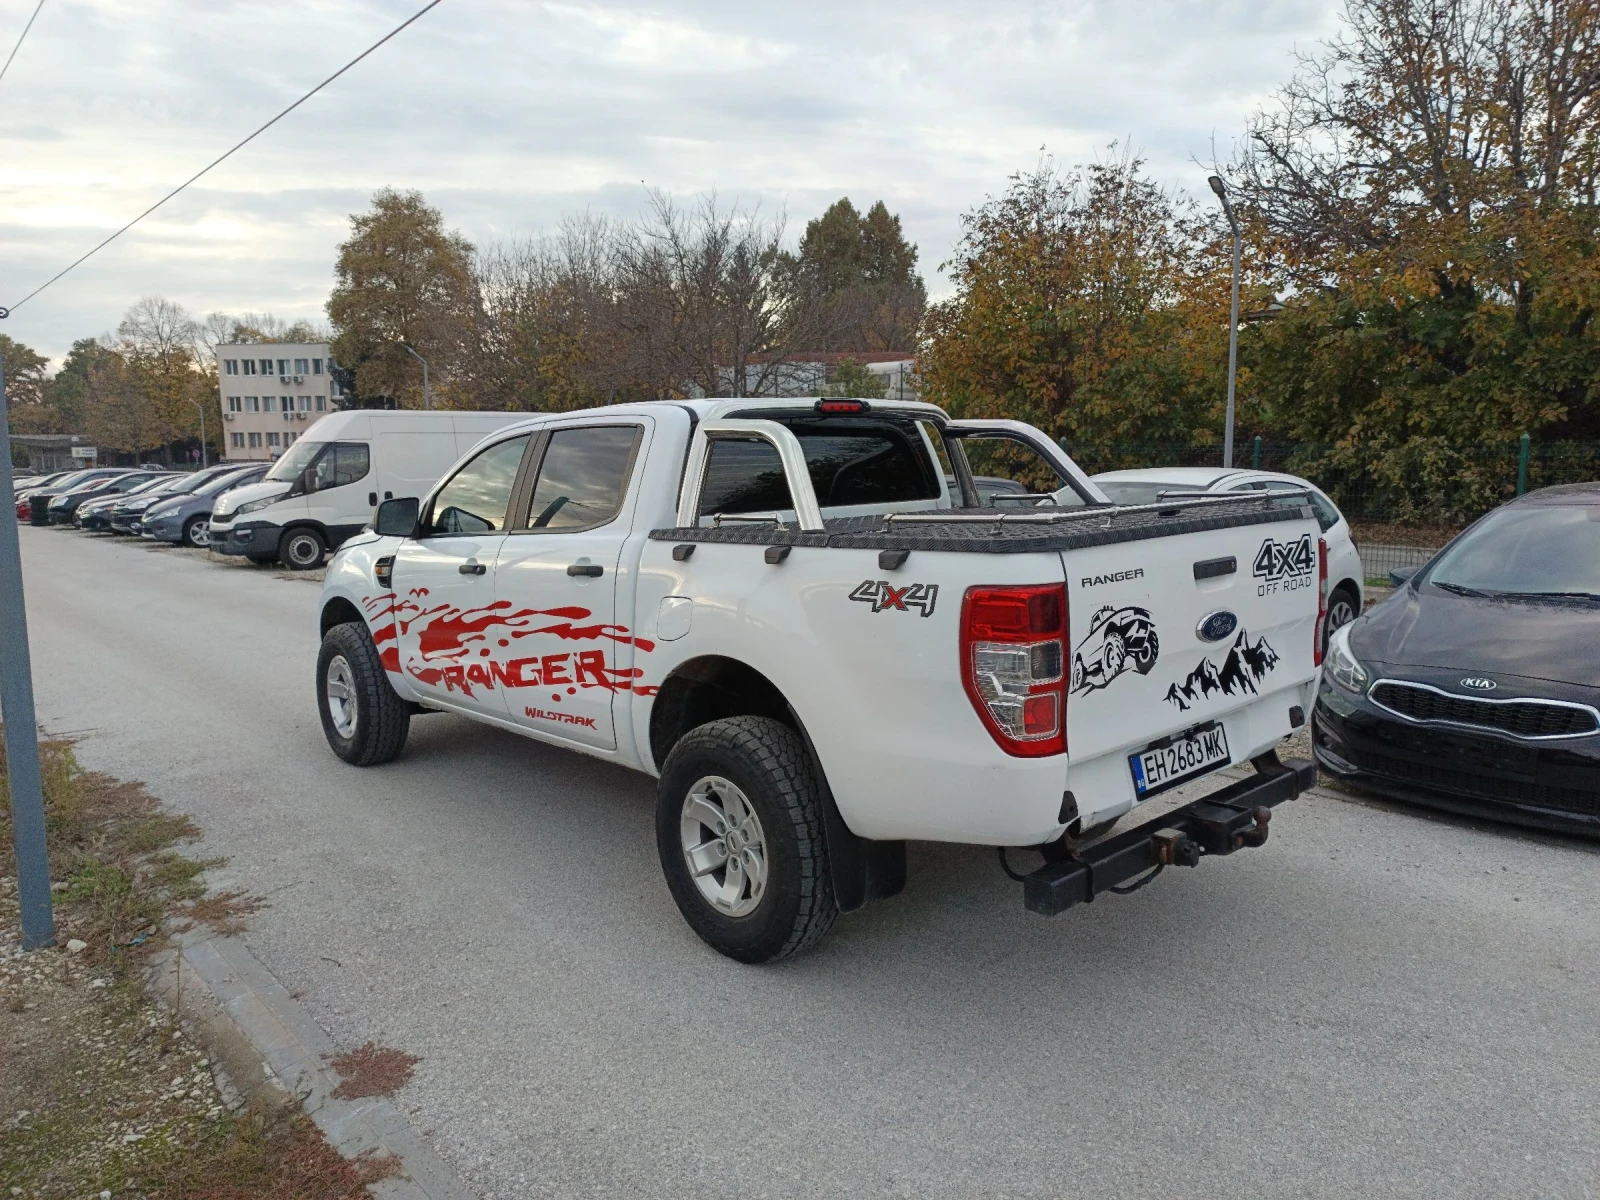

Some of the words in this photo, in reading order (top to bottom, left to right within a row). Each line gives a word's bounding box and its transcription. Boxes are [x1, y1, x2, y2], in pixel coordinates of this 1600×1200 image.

[1081, 568, 1144, 588] RANGER
[1257, 582, 1279, 597] OFF
[1283, 576, 1311, 592] ROAD
[442, 650, 612, 696] RANGER
[1464, 677, 1490, 688] KIA
